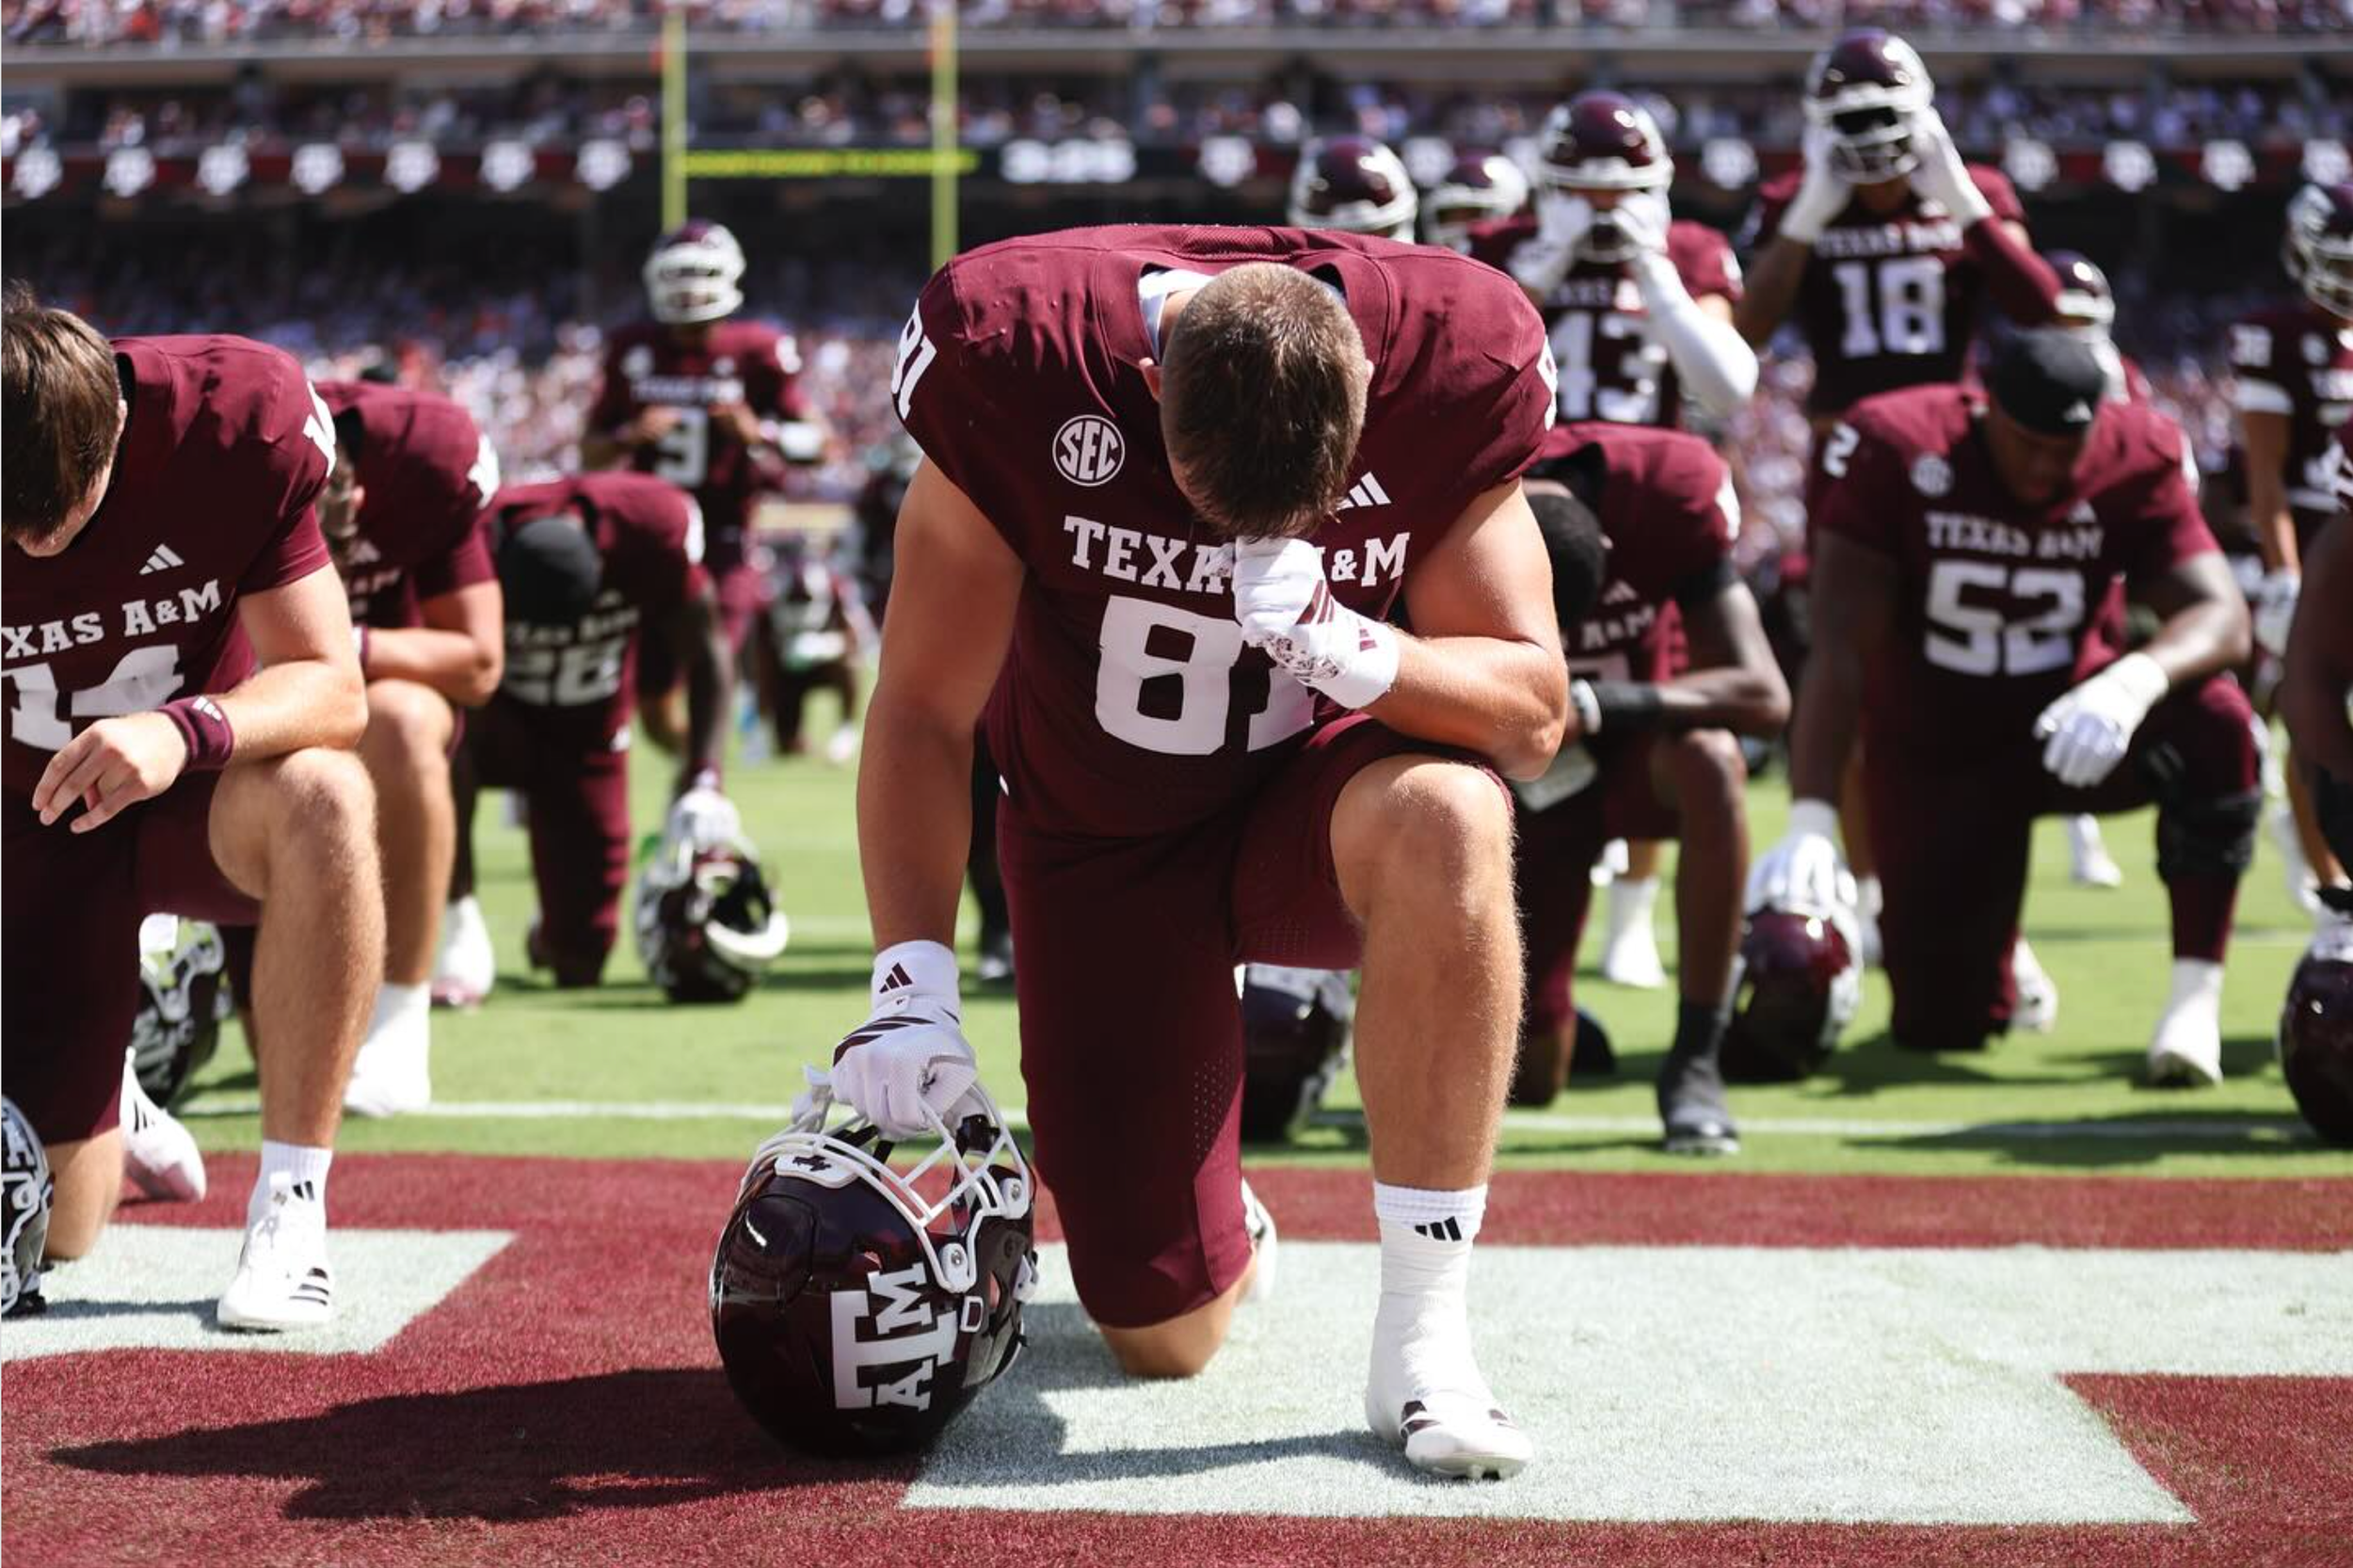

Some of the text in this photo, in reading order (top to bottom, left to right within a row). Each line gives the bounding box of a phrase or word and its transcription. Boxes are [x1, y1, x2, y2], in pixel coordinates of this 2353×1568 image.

[1833, 258, 1945, 358] 18
[1551, 311, 1664, 422] 43
[1057, 418, 1121, 483] SEC
[1823, 423, 1861, 478] 2
[1064, 515, 1228, 595] TEXA
[1925, 510, 2031, 556] TEXAS
[1, 579, 221, 658] XAS A&M
[1925, 560, 2085, 677] 52
[1, 644, 185, 752] 14
[1095, 595, 1316, 756] 81
